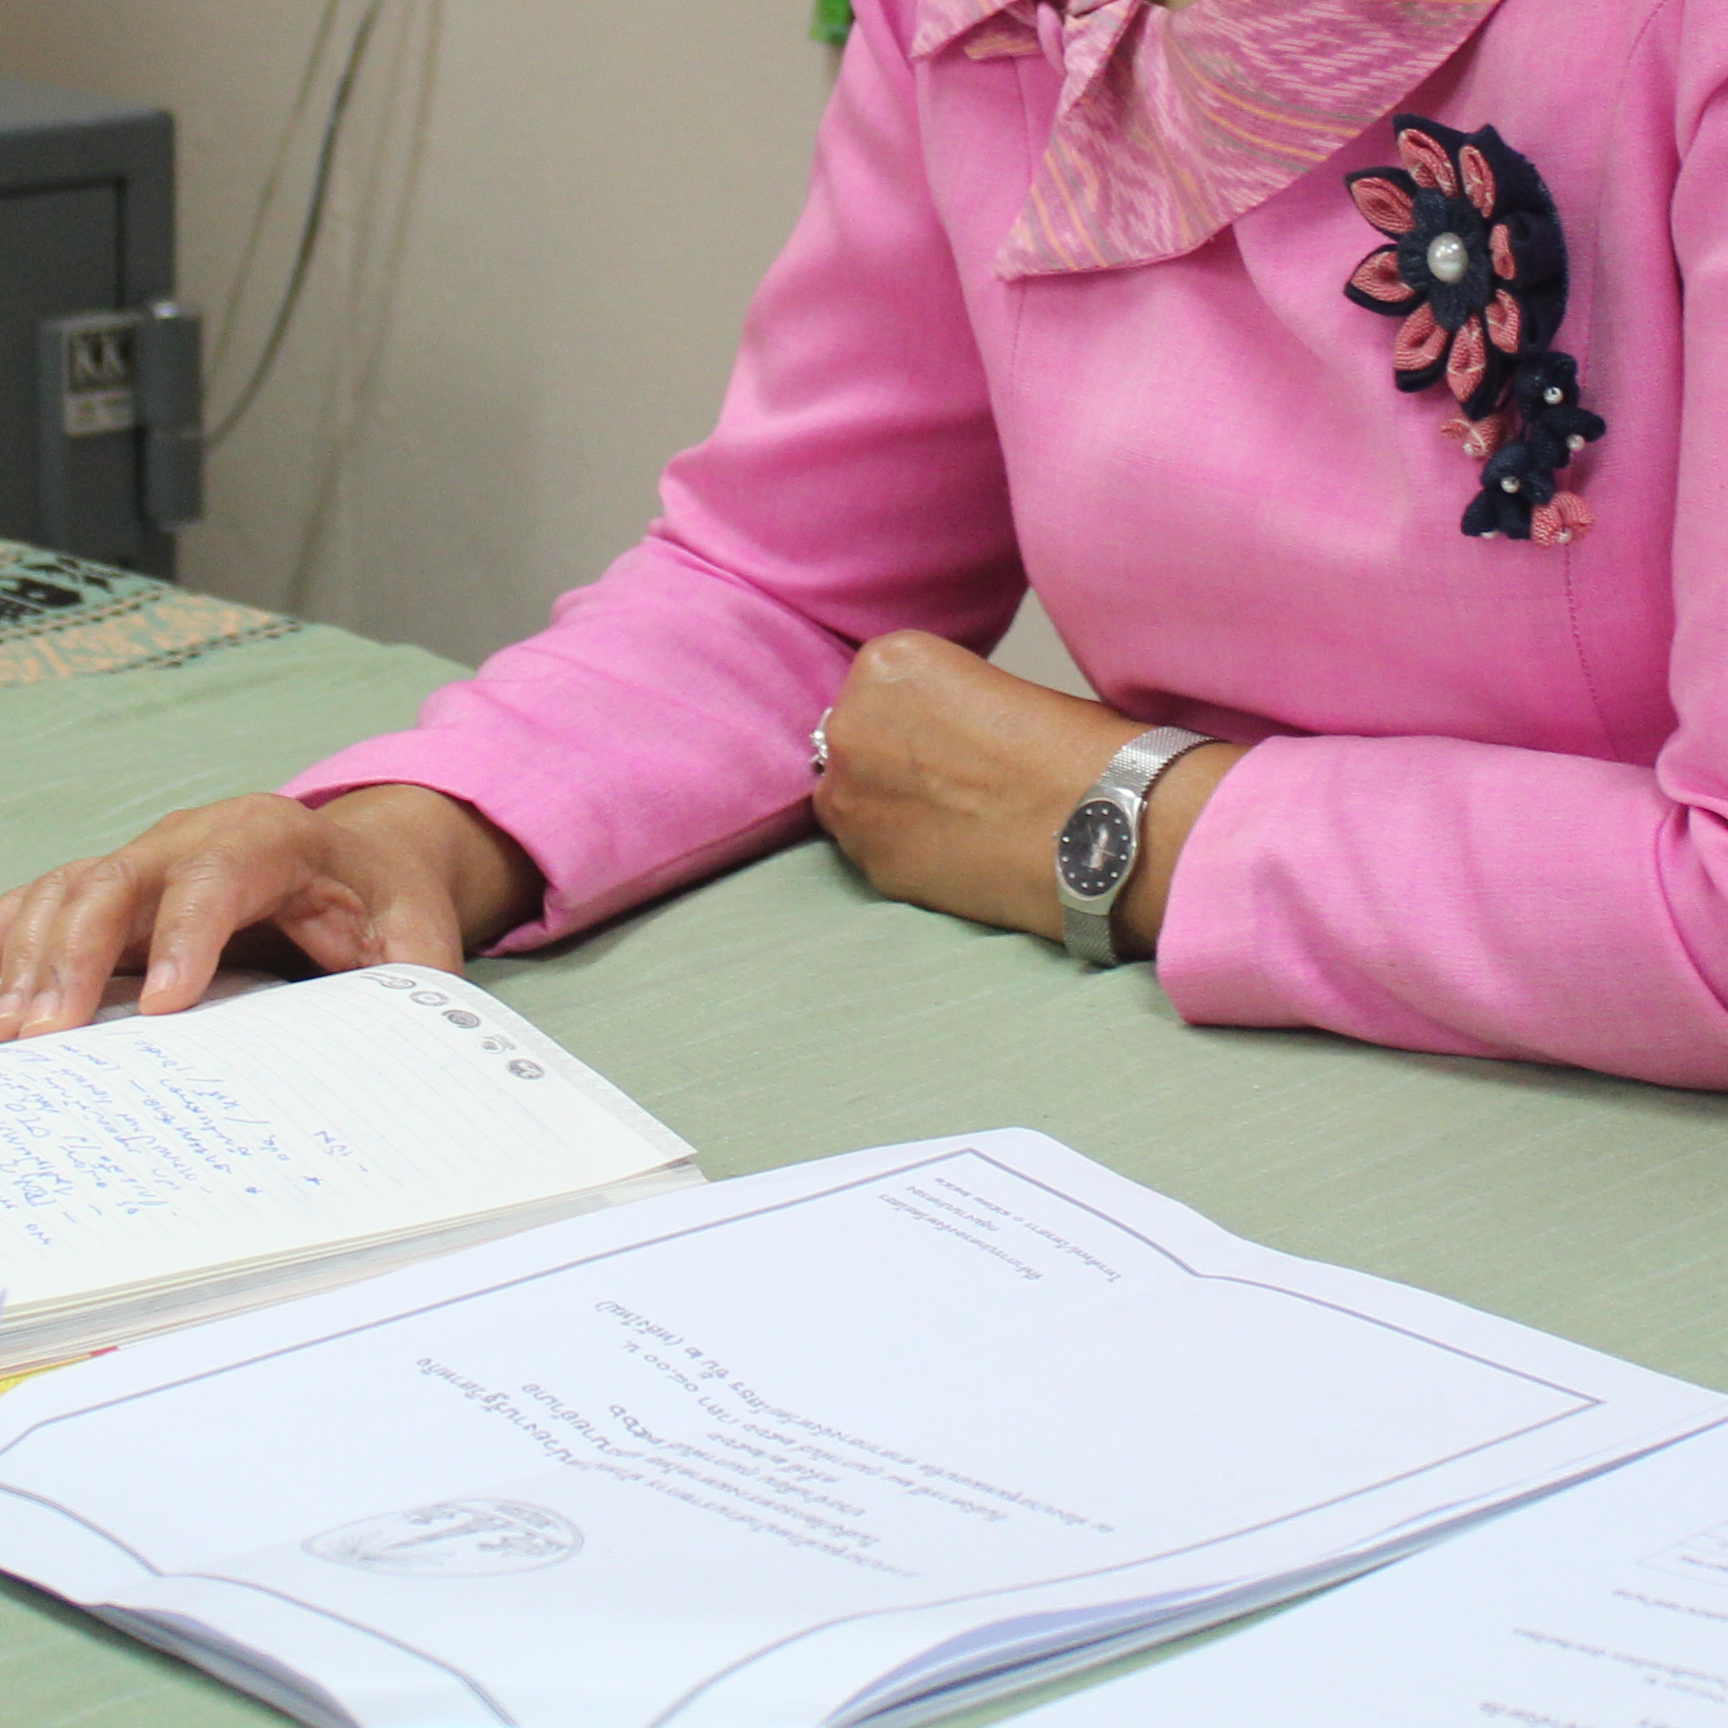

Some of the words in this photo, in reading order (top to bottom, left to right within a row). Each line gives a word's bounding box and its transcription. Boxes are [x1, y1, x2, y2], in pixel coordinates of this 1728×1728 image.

[593, 1299, 684, 1346] (หลังใหม่)
[621, 1339, 642, 1354] น.
[697, 1358, 730, 1380] ชั้น
[696, 1395, 740, 1424] เวลา
[658, 1442, 759, 1477] กุมภาพันธ์
[777, 1463, 839, 1483] ครั้งที่
[790, 1444, 883, 1476] กุมภาพันธ์
[760, 1475, 866, 1517] ประจำเดือน
